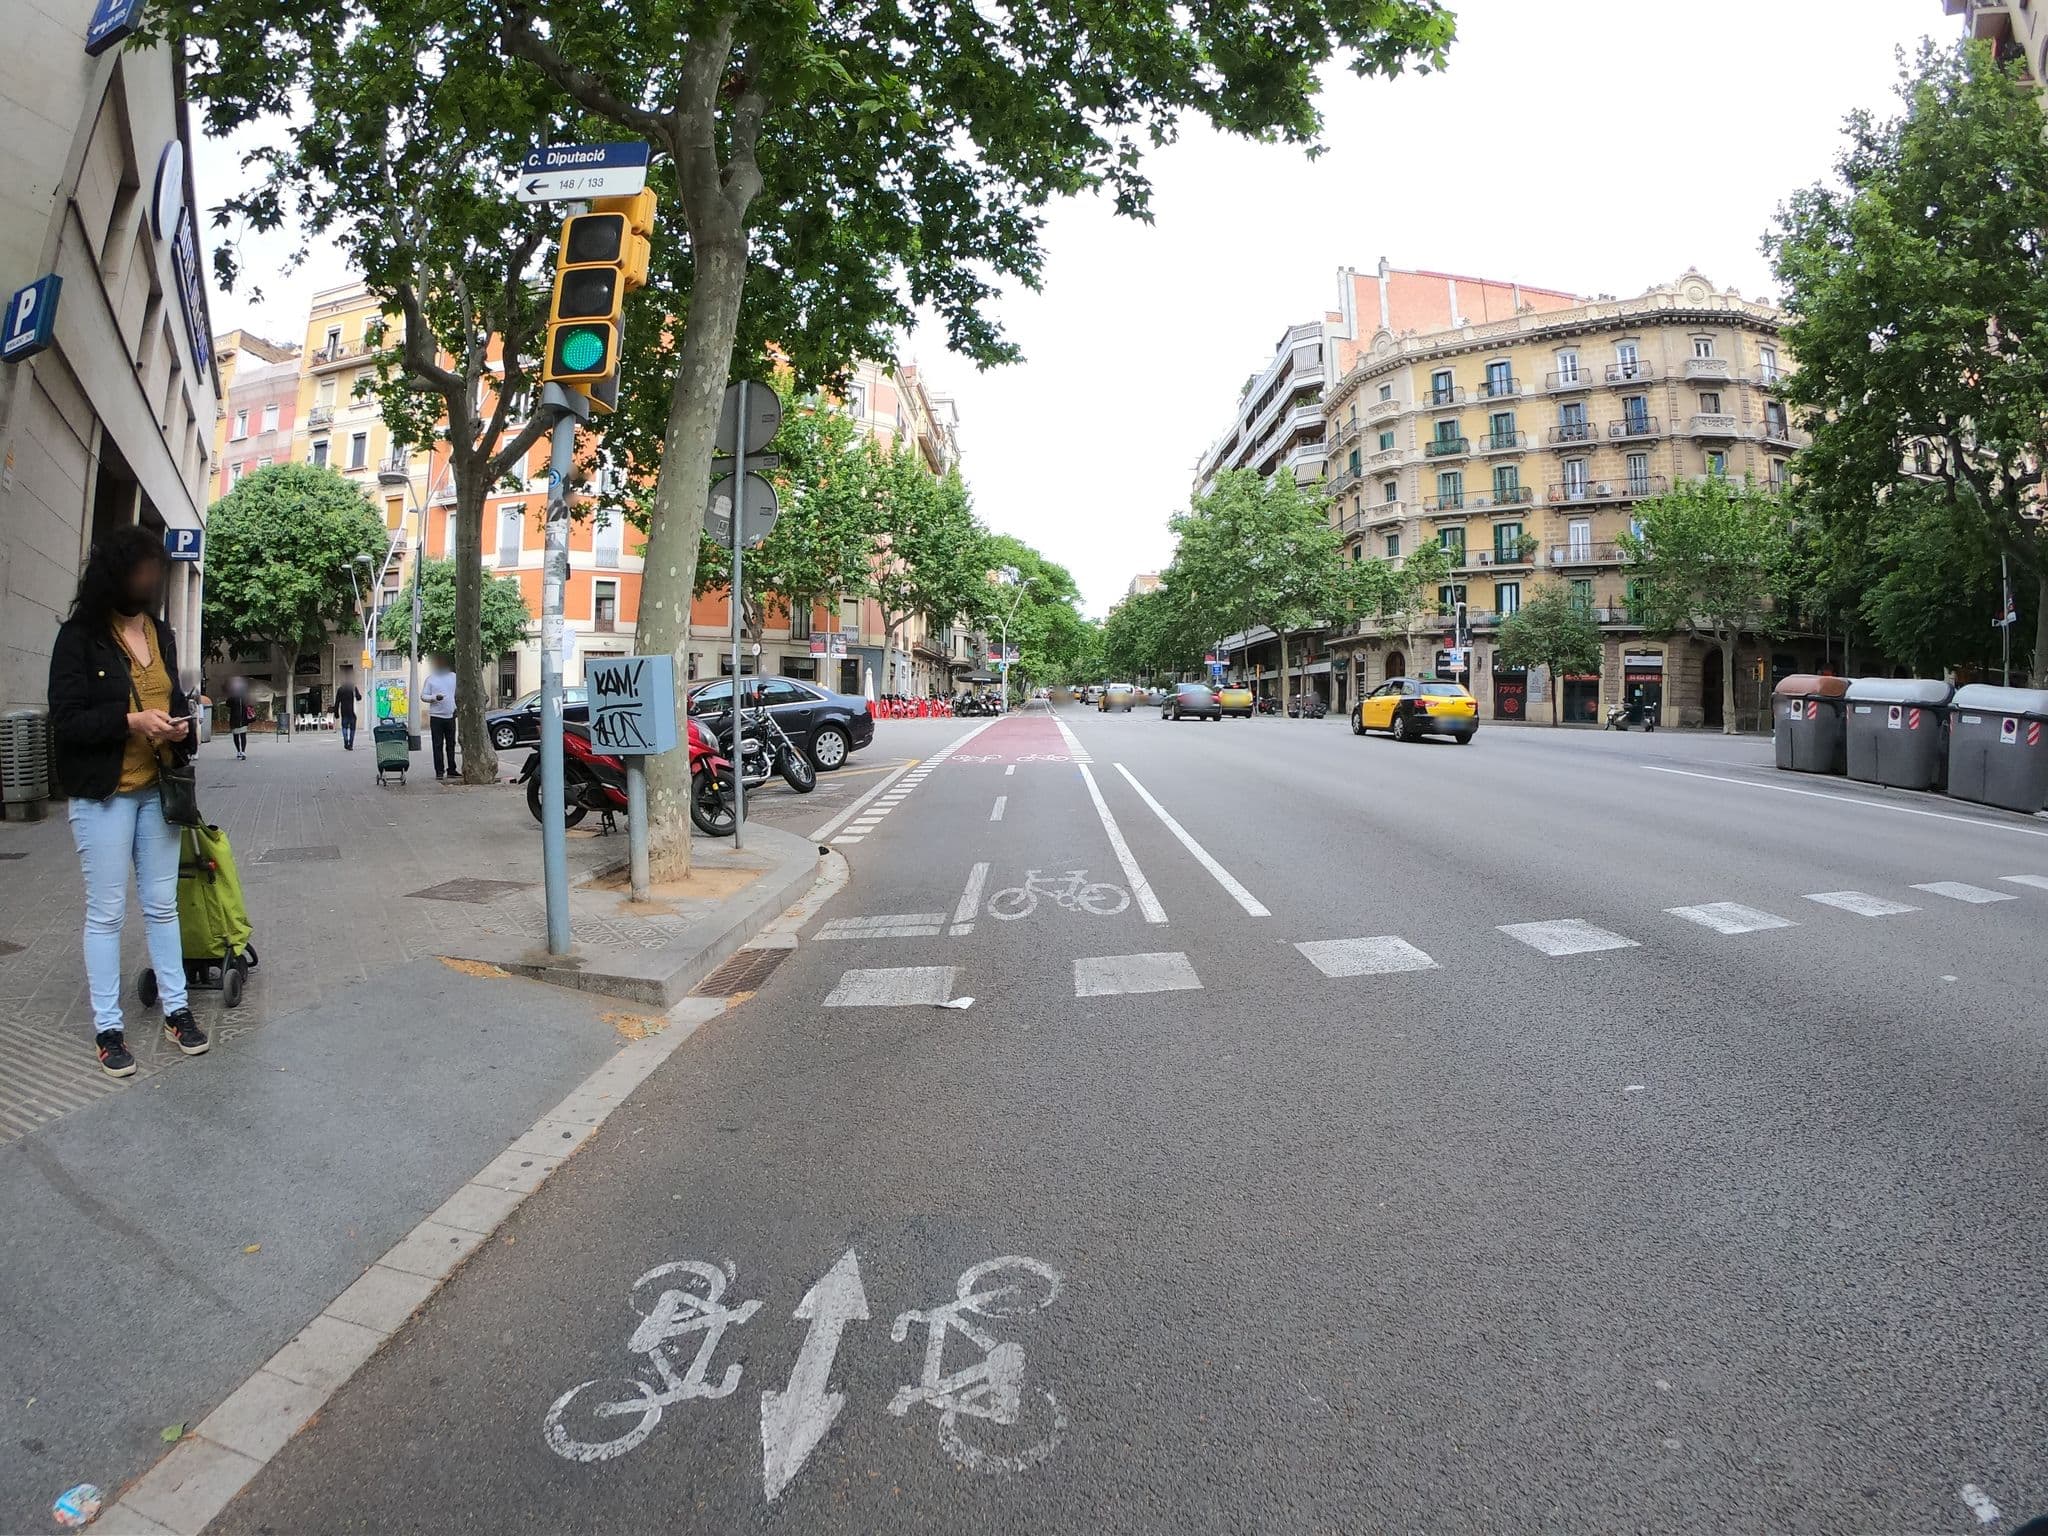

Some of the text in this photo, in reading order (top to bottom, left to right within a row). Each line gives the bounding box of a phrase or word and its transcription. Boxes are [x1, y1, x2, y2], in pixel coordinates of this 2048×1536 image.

[528, 149, 605, 166] C. Diputació
[559, 179, 575, 190] 148
[588, 177, 604, 188] 133
[13, 287, 37, 336] P
[178, 530, 193, 551] P
